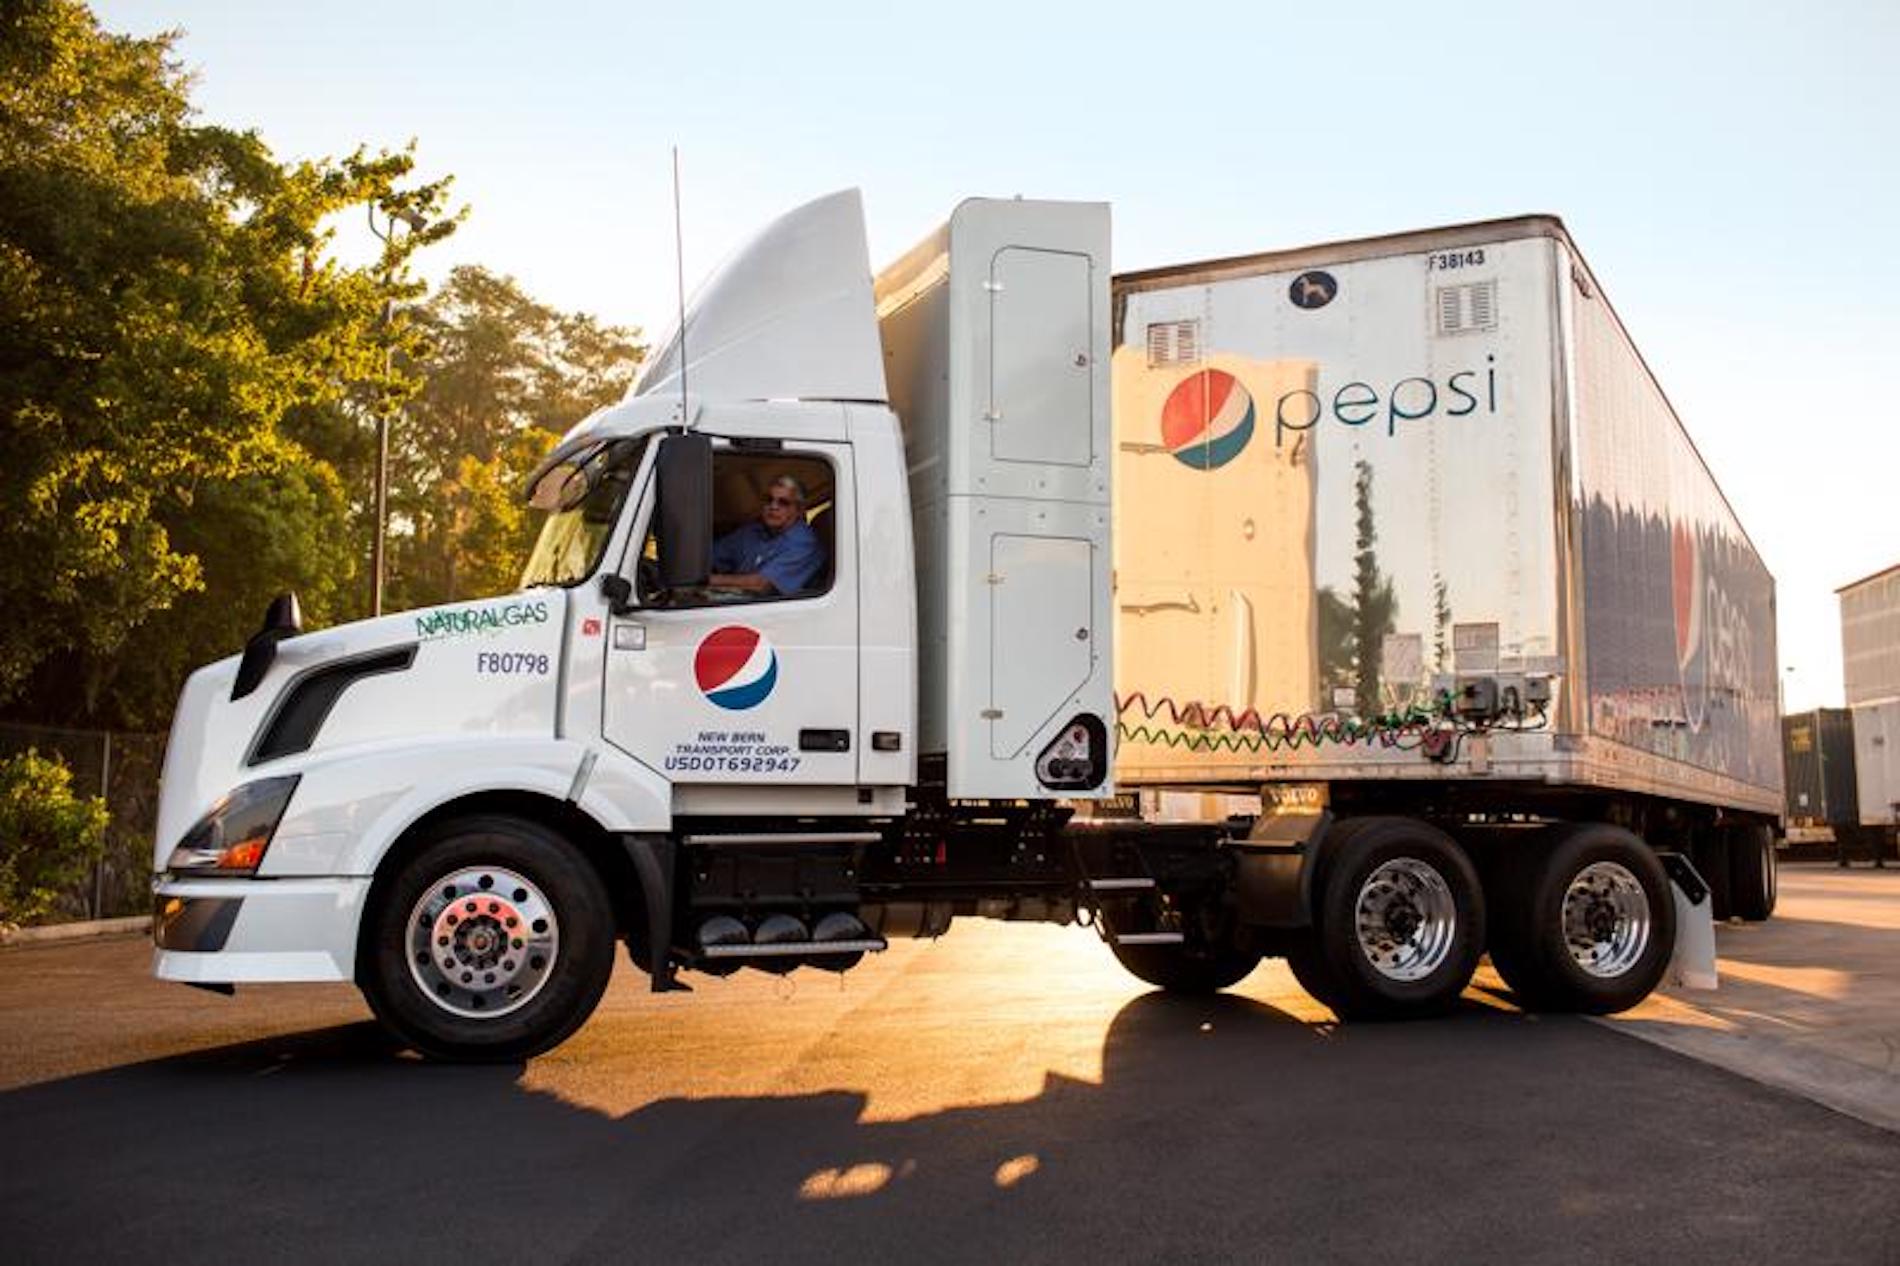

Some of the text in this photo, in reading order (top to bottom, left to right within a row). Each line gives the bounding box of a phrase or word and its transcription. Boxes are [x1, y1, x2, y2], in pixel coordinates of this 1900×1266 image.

[1428, 250, 1486, 271] F38143
[1276, 353, 1496, 447] pepsi
[477, 652, 549, 675] F80798
[697, 731, 766, 743] NEW BERN
[676, 744, 754, 756] TRANSPORT
[664, 756, 801, 772] USDOT692947
[1271, 786, 1319, 804] VOLVO
